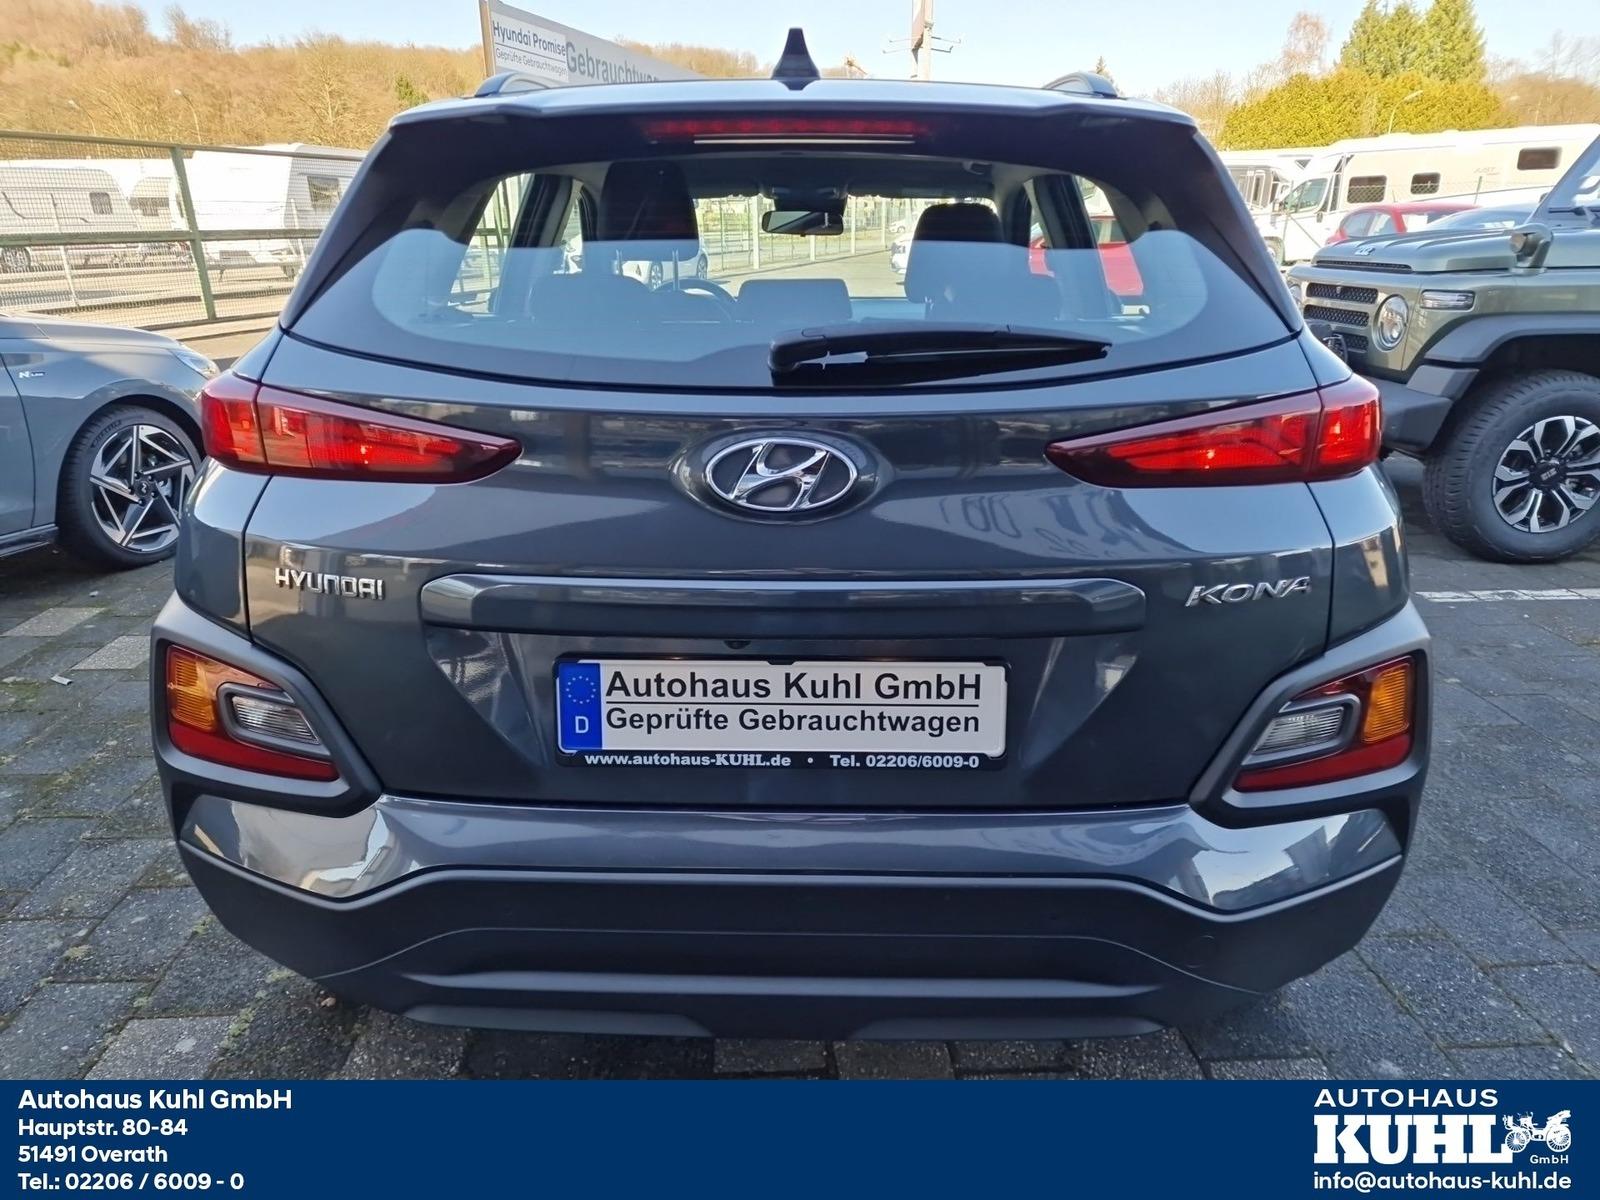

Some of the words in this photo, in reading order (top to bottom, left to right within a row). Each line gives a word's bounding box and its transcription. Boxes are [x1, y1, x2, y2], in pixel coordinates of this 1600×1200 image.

[493, 20, 531, 46] Hyundai
[533, 33, 566, 56] Promise
[275, 568, 383, 600] HYUNDAI
[1185, 576, 1311, 607] KONA
[606, 671, 771, 699] Autohaus
[785, 672, 861, 699] Kuhl
[874, 673, 981, 700] GmbH
[575, 716, 589, 733] D
[606, 707, 729, 735] Geprüfte
[739, 709, 980, 737] Gebrauchtwagen
[584, 753, 792, 767] www.autohaus-KUHL.de
[829, 754, 861, 767] Tel.
[865, 755, 980, 768] 02206/6009-0
